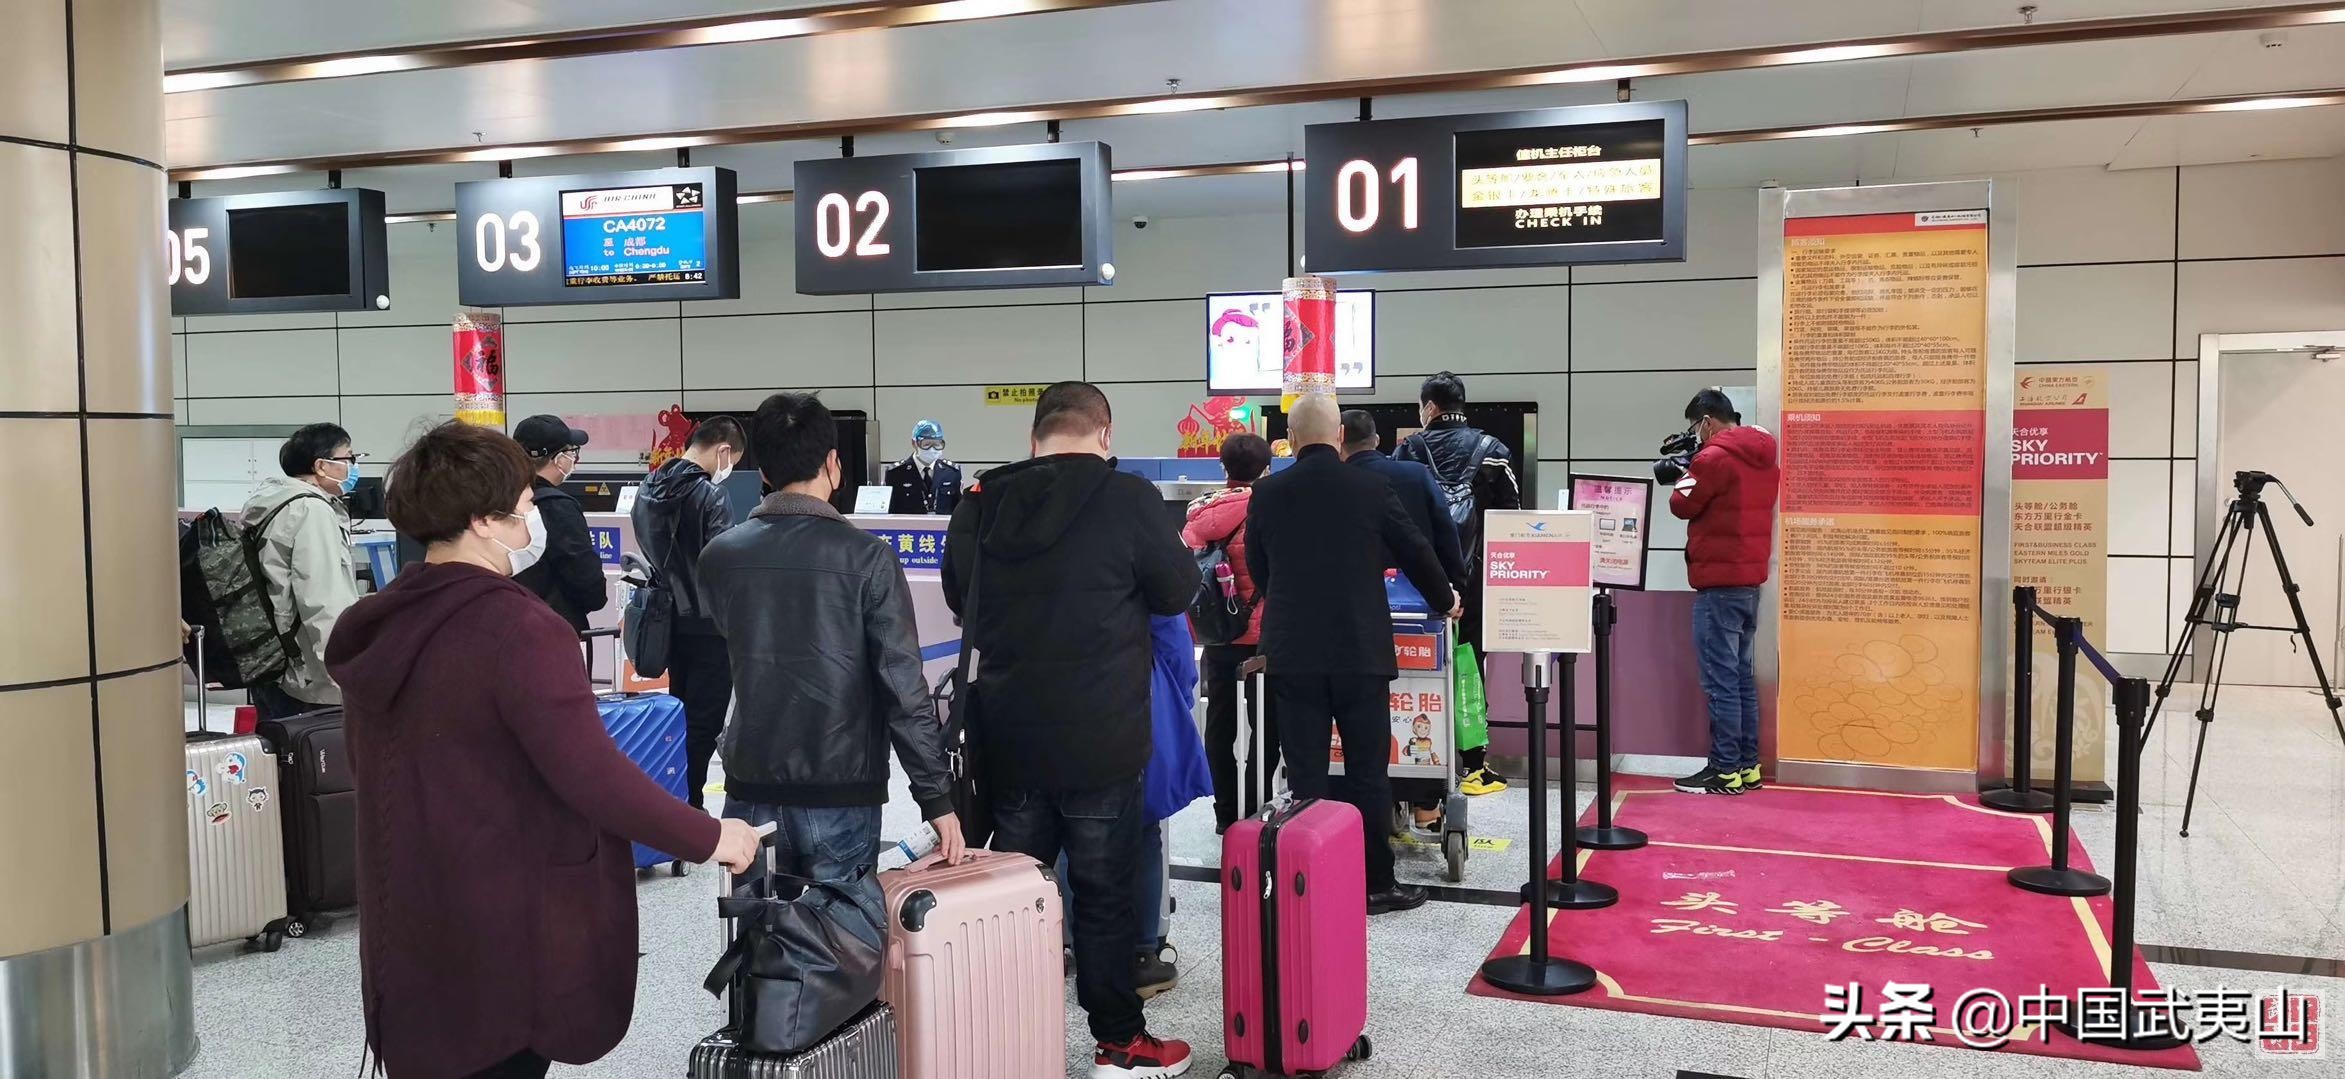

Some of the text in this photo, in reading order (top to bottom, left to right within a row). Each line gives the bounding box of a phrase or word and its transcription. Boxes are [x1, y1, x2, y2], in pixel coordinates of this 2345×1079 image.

[1336, 157, 1418, 232] 01
[603, 217, 666, 233] CA4072
[816, 190, 891, 258] 02
[1515, 215, 1602, 228] CHECK IN
[475, 211, 541, 272] 03
[603, 245, 670, 257] to Chengdu
[2012, 440, 2049, 452] SKY
[2012, 453, 2099, 465] PRIORITY
[2014, 512, 2083, 521] 东方万里行金卡
[2013, 522, 2093, 531] 天合联盟超级精英
[912, 555, 939, 564] outside
[1490, 561, 1515, 570] SKY
[1490, 570, 1548, 579] PRIORITY
[1390, 692, 1443, 712] 轮胎
[1659, 892, 1989, 937] 头等舱
[1650, 918, 1785, 943] First
[1841, 936, 1996, 960] Class
